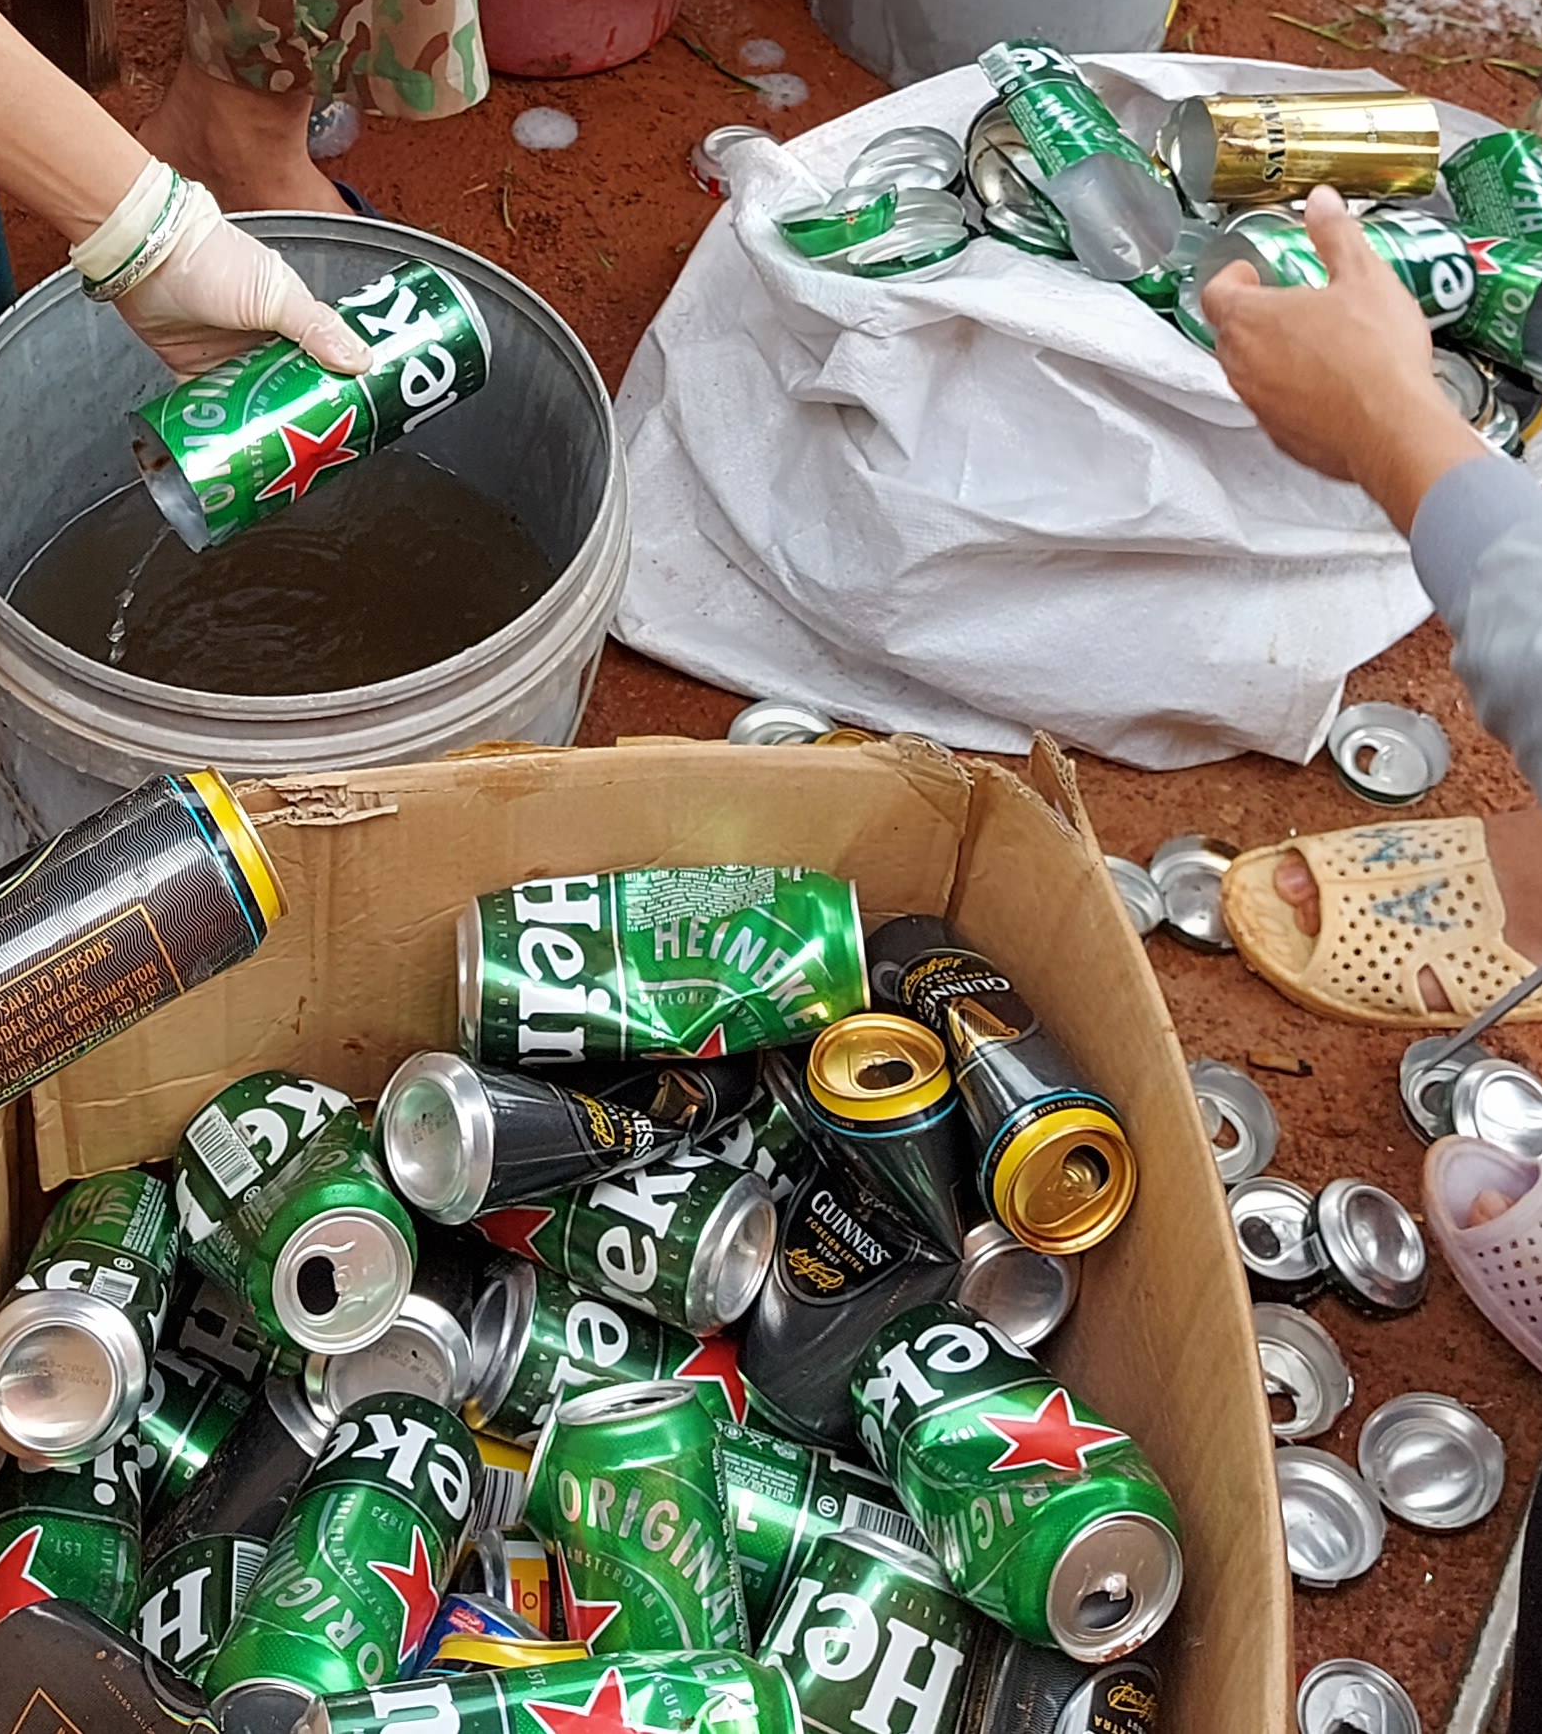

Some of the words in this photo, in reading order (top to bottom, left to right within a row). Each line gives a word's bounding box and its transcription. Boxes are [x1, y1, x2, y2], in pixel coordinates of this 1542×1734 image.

[31, 972, 56, 997] TO
[50, 936, 117, 986] PERSONS
[111, 995, 136, 1018] DO
[135, 977, 167, 1003] NOT
[0, 1016, 66, 1065] ALCOHOL
[61, 958, 161, 1028] CONSUMPTION
[810, 1189, 893, 1266] GUINNESS
